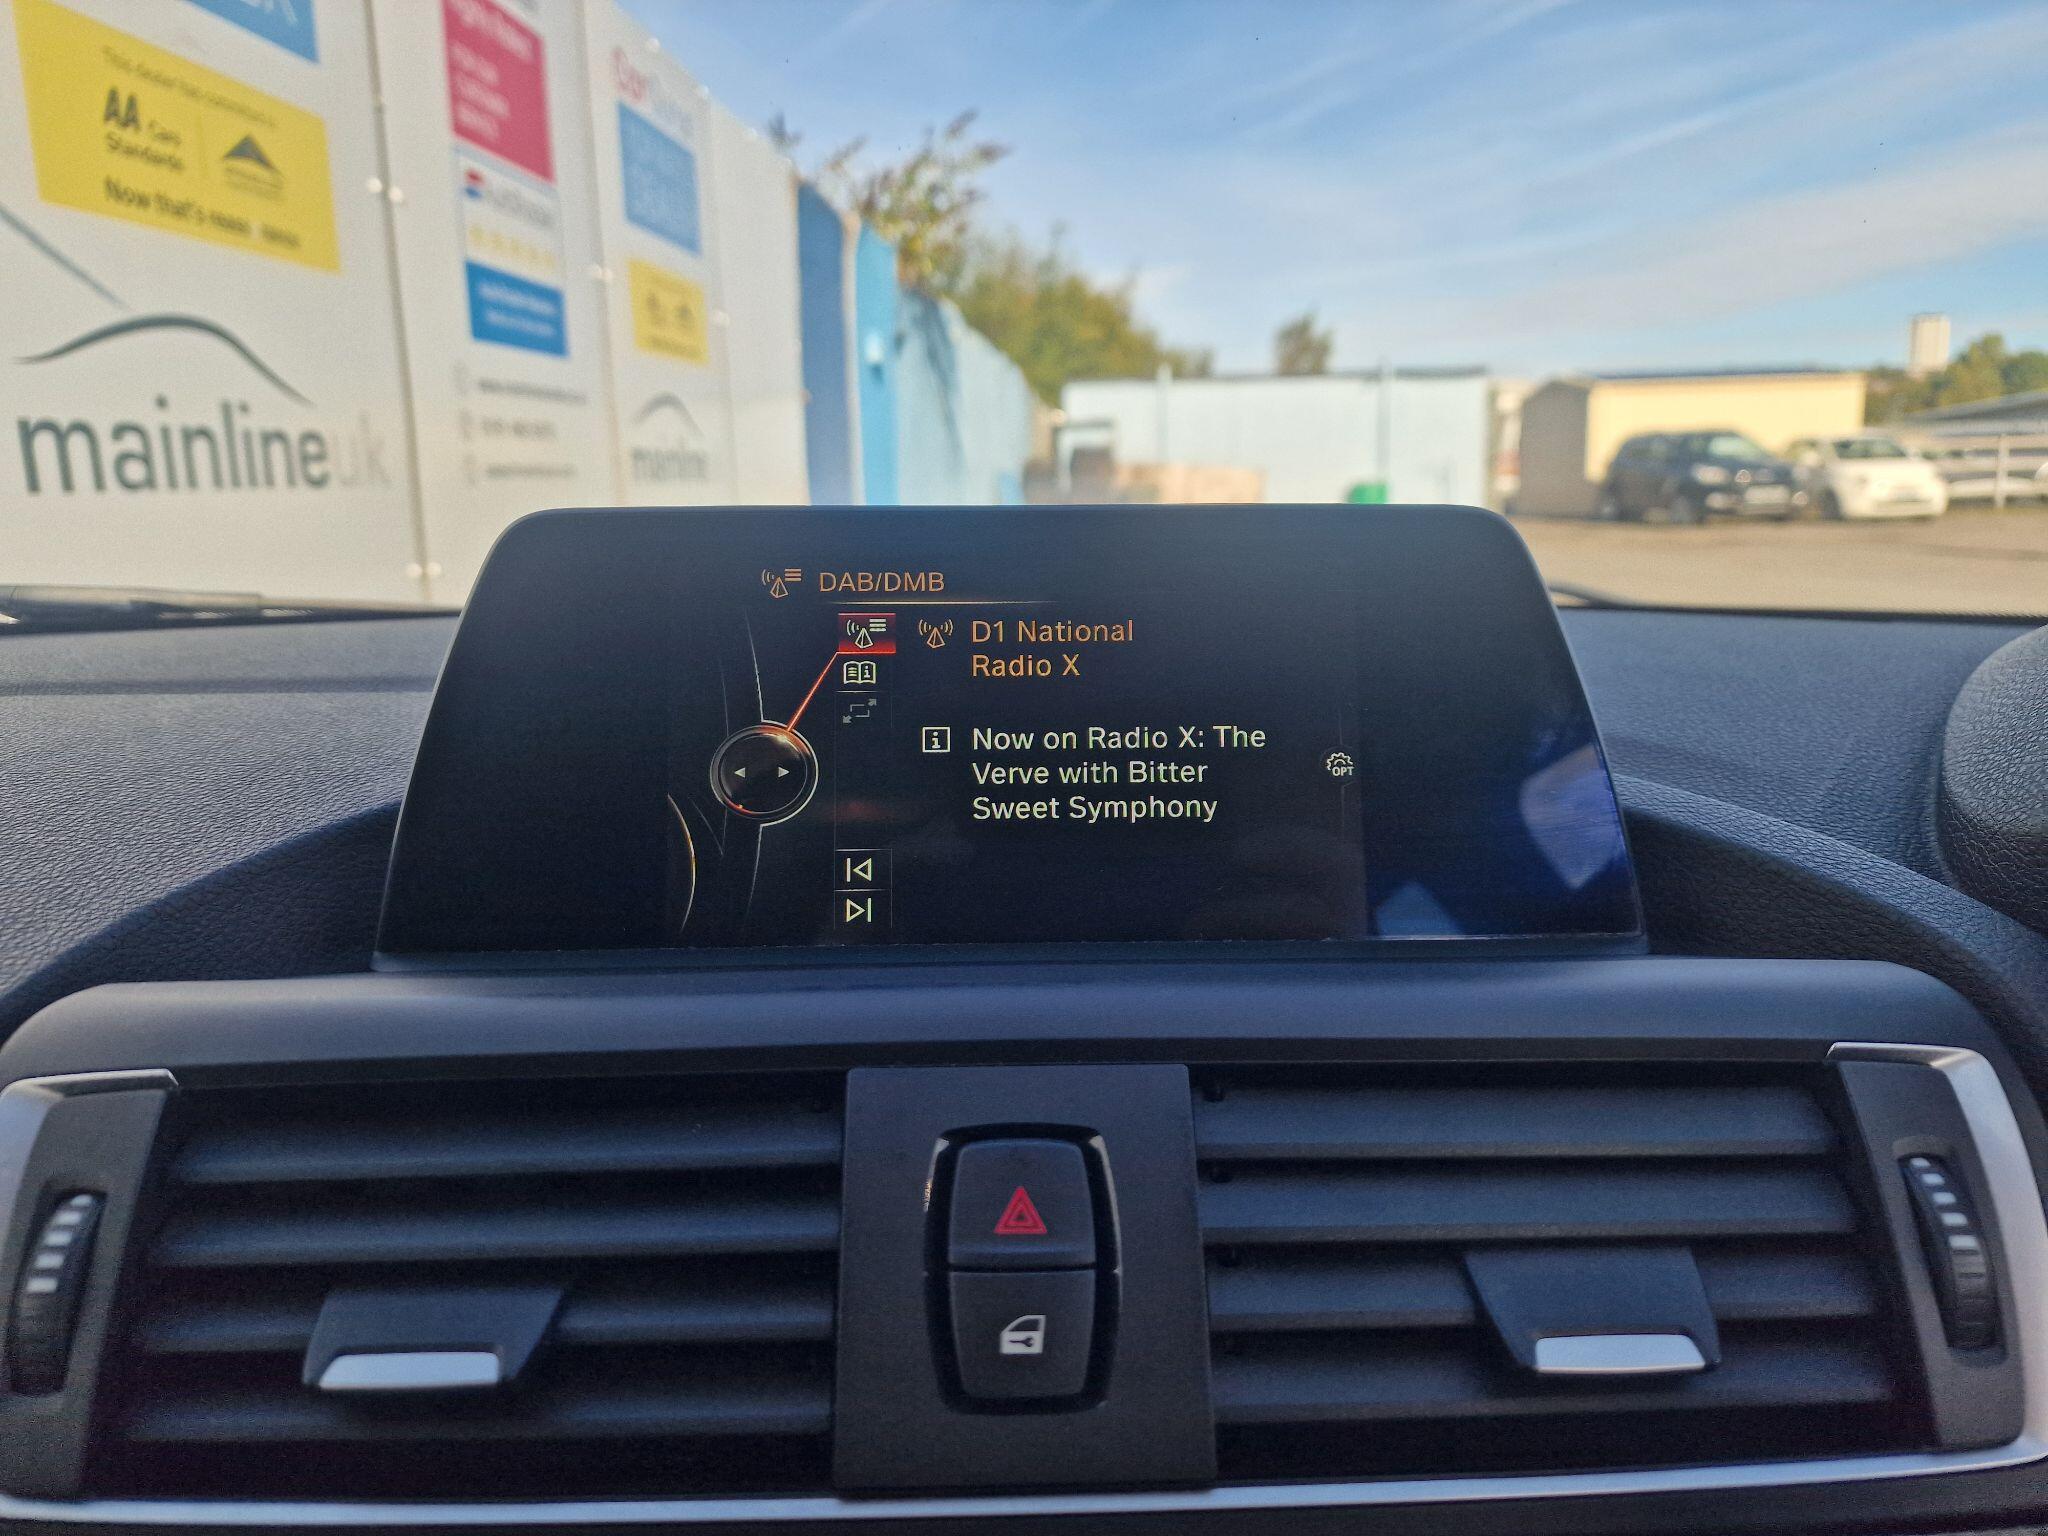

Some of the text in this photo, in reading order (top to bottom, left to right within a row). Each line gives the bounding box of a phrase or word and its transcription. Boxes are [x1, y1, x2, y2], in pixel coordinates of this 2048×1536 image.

[103, 85, 141, 131] AA
[103, 174, 152, 209] Now
[819, 571, 945, 592] DAB/DMB
[972, 619, 1133, 643] D1 National
[972, 653, 1081, 677] Radio X
[973, 725, 1266, 750] Now on Radio X: The
[972, 760, 1209, 785] Verve with Bitter
[1332, 766, 1356, 777] OPT
[973, 795, 1218, 824] Sweet Symphony
